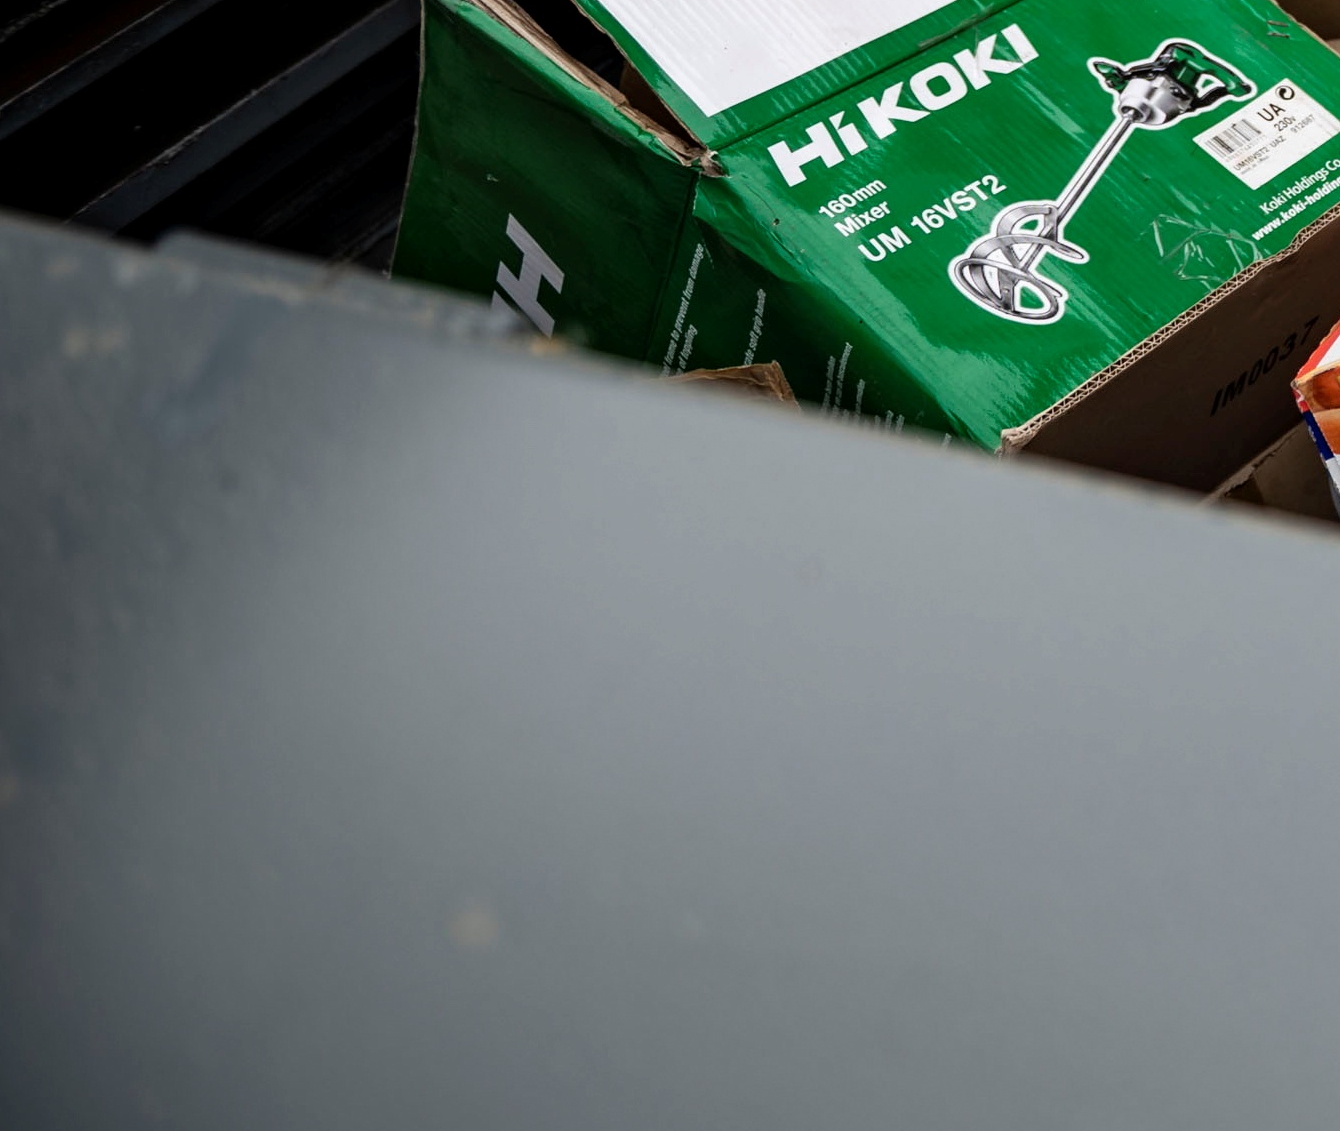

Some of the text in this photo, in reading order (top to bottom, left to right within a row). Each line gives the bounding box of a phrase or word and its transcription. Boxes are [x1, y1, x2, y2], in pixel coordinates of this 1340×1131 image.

[1257, 103, 1286, 122] UA
[818, 179, 887, 218] 160mm
[1259, 192, 1288, 215] Koki
[1283, 167, 1329, 200] Holdings
[833, 201, 890, 237] Mixer
[857, 175, 1007, 262] UM 16VST2
[689, 243, 704, 280] damage
[682, 277, 695, 299] from
[674, 296, 689, 334] prevent
[752, 315, 763, 336] grip
[671, 330, 680, 341] to
